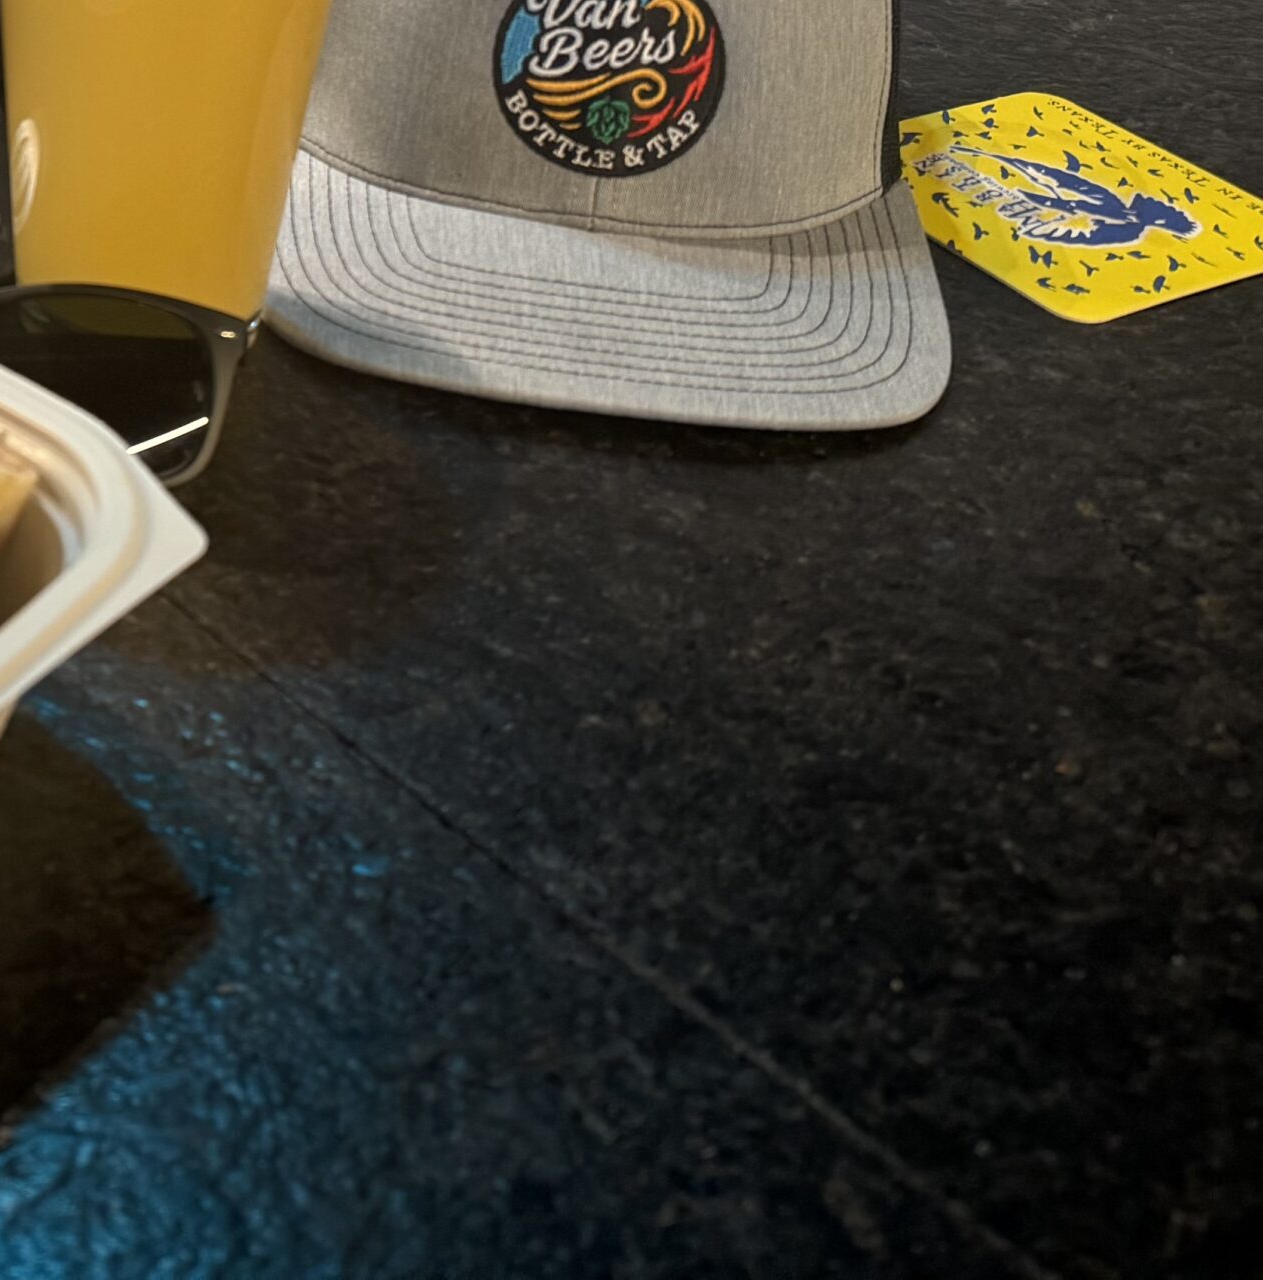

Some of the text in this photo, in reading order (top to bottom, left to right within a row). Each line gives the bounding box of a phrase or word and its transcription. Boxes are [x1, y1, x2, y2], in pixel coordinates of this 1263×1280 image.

[528, 26, 676, 78] Beers
[505, 89, 701, 169] BOTTLE & TAP
